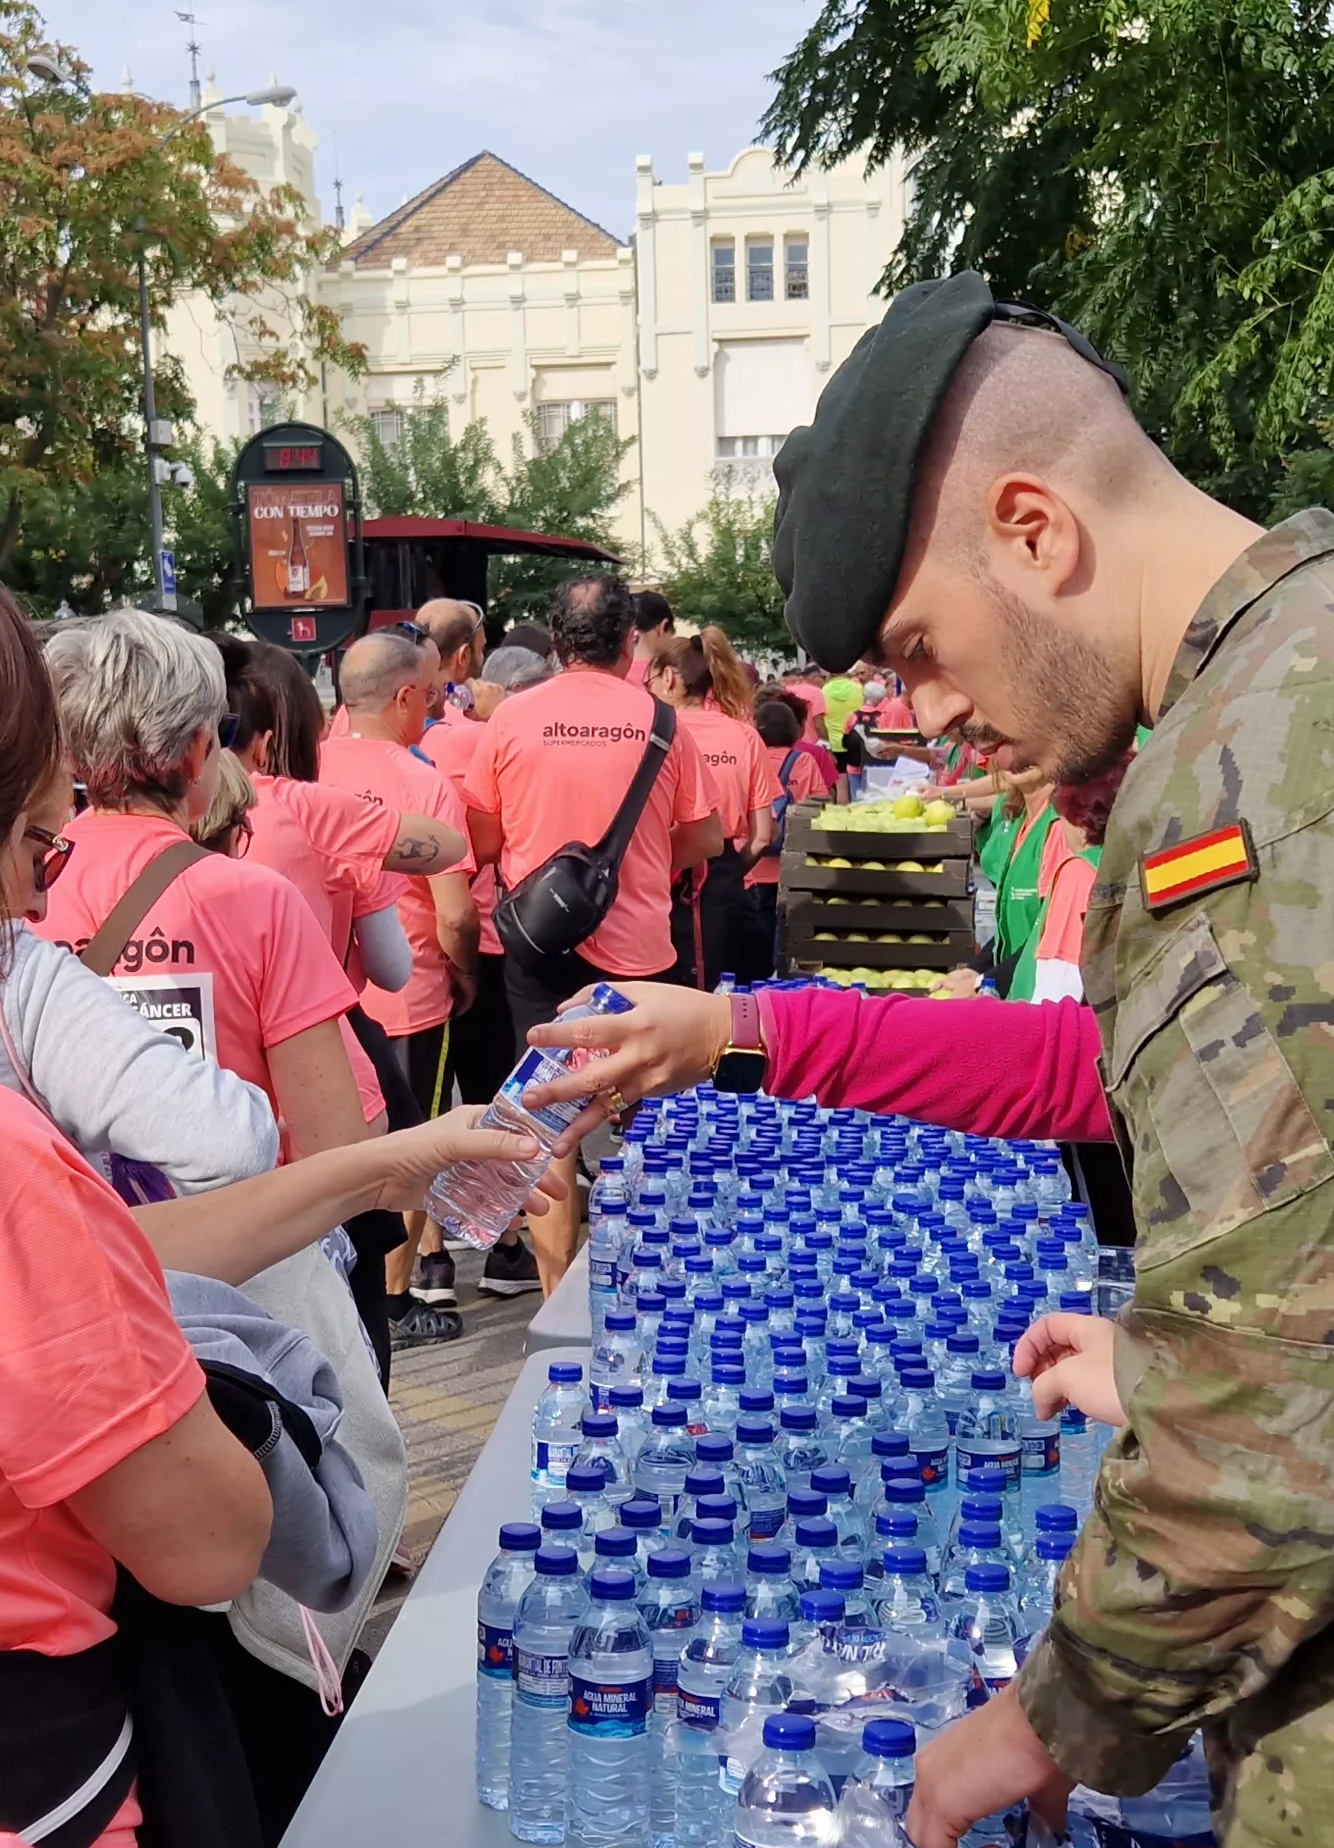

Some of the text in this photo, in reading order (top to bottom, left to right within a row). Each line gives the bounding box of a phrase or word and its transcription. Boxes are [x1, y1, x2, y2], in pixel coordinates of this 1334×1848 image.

[254, 504, 340, 519] CON TIEMPO
[543, 722, 646, 742] altoaragôn
[583, 1690, 637, 1702] AGUA MINERAL
[592, 1702, 627, 1713] NATURAL
